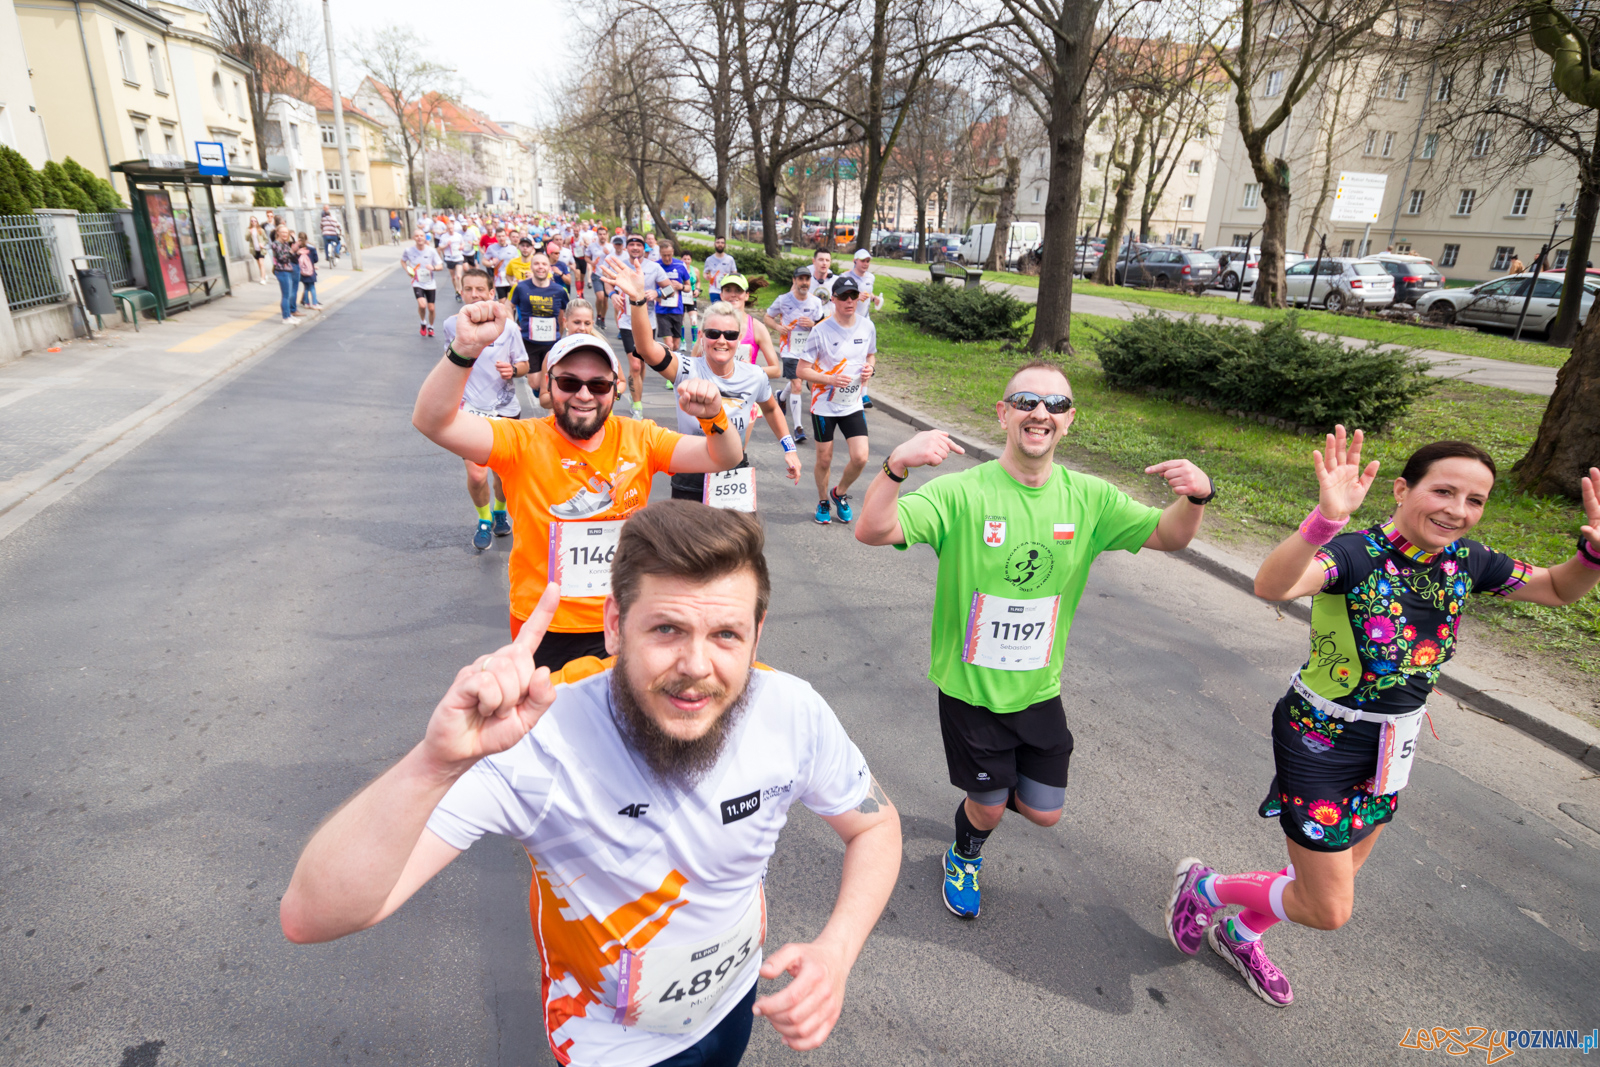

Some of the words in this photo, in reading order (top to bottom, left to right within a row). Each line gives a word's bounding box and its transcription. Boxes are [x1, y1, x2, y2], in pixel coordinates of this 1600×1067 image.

[715, 482, 747, 496] 5598
[569, 544, 616, 565] 1146
[991, 621, 1046, 641] 11197
[999, 643, 1032, 651] Sebastian
[618, 803, 650, 818] 4F
[740, 796, 758, 813] PKO
[659, 936, 753, 1003] 4893
